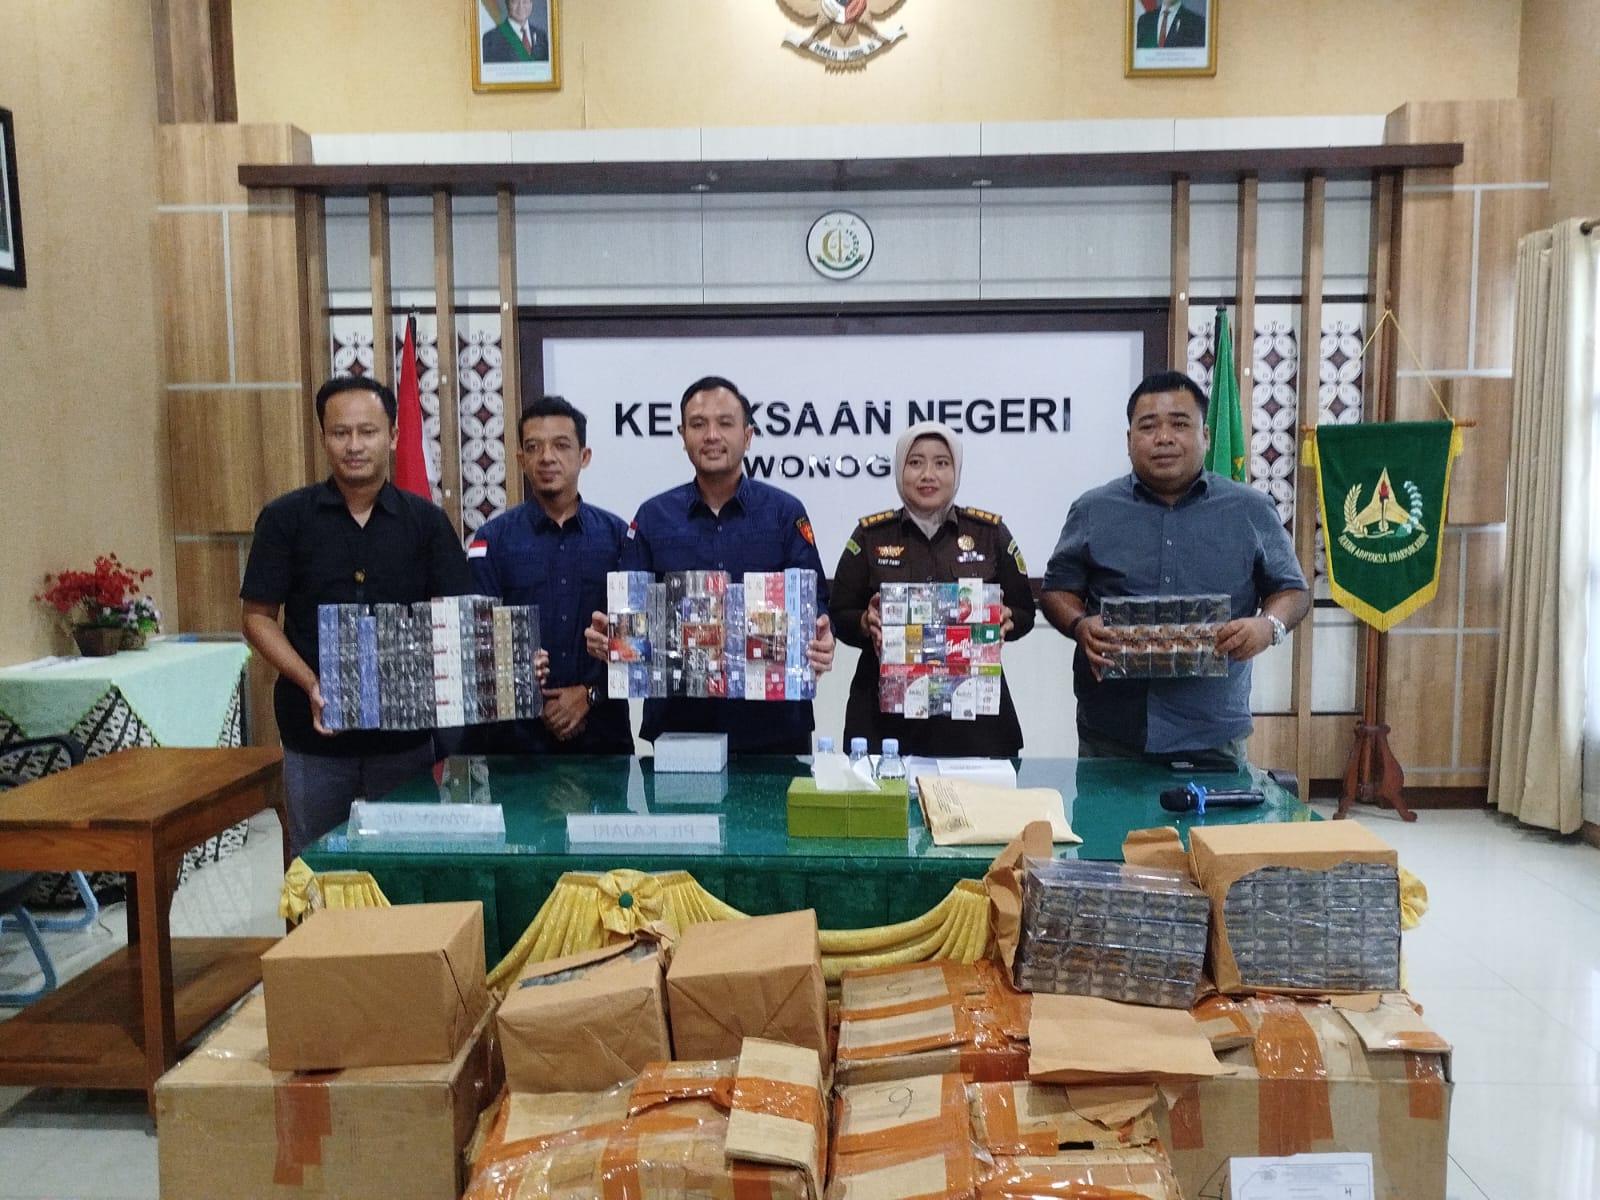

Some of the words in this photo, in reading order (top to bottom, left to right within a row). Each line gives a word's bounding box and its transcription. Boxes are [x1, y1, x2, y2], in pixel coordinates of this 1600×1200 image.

[615, 401, 891, 436] KEKSAAN
[908, 397, 1072, 434] NEGERI
[743, 455, 892, 478] WONOG
